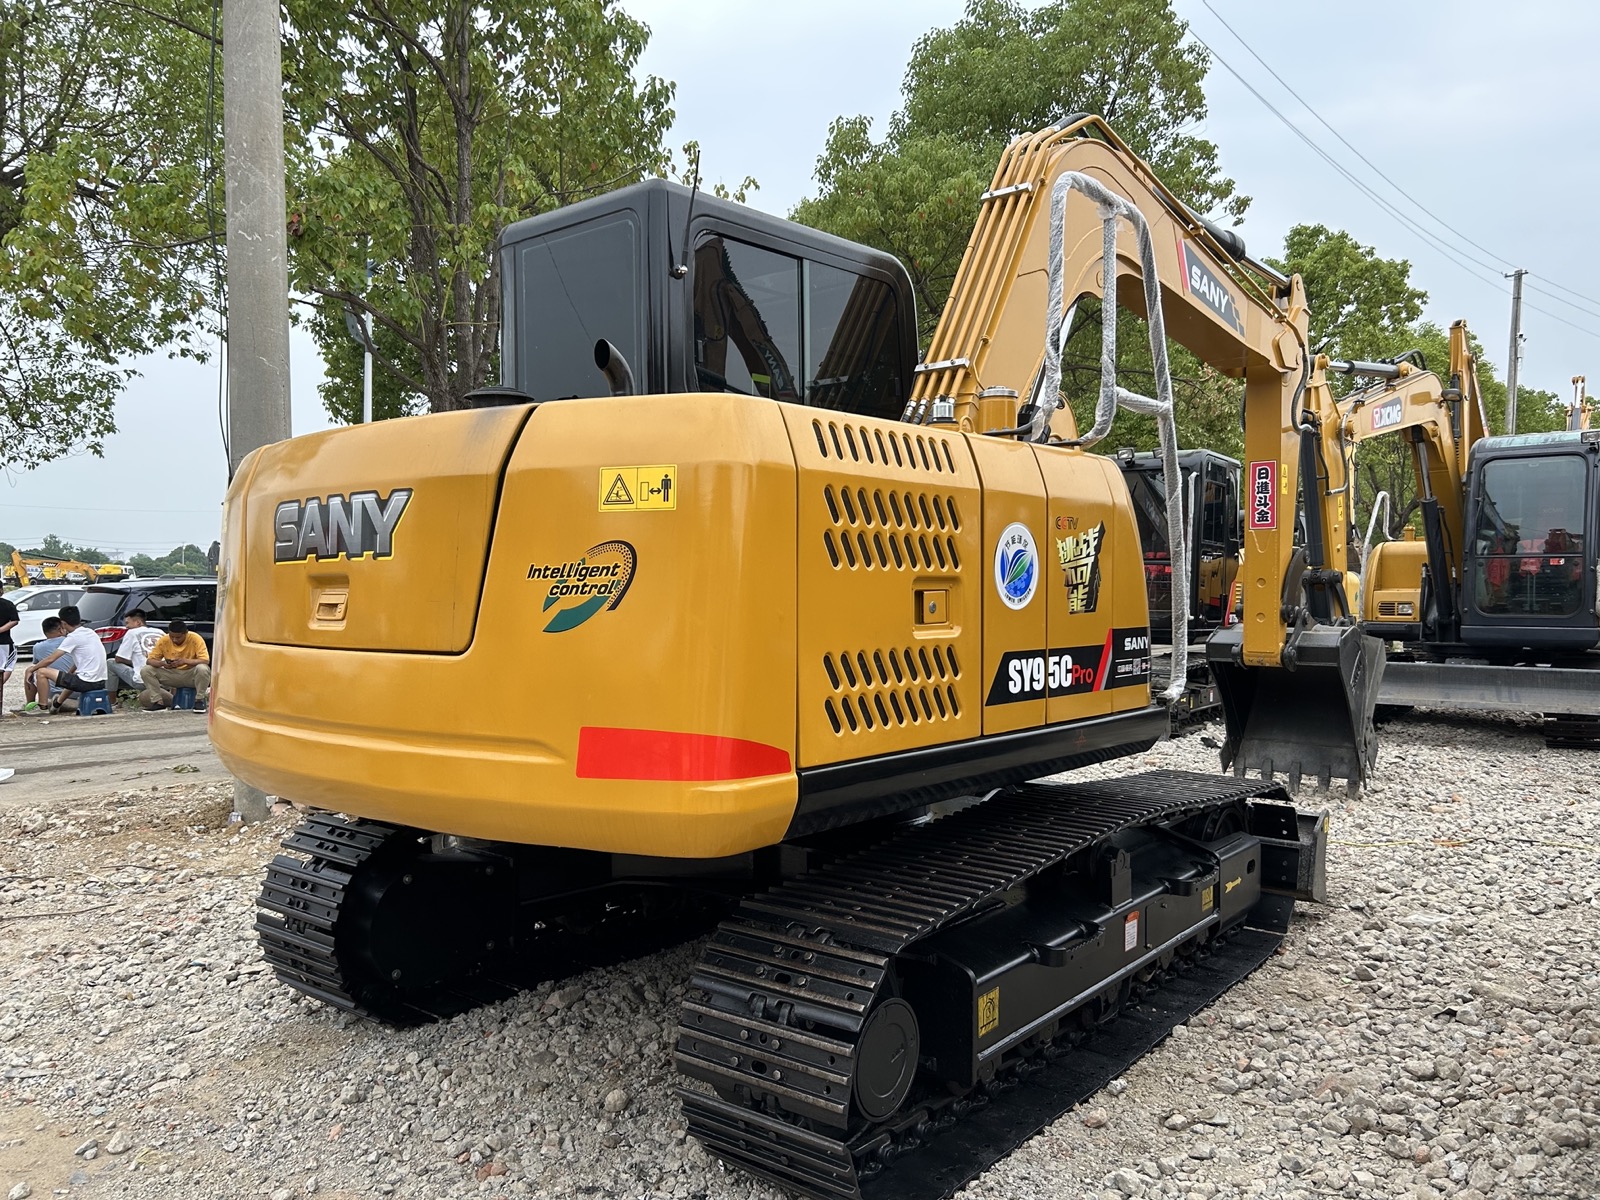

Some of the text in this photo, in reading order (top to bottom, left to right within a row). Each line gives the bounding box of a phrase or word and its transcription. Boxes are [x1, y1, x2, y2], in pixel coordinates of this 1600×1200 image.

[1191, 265, 1229, 313] SANY
[1380, 404, 1402, 426] XCMG
[1254, 466, 1271, 524] 日進斗金
[274, 488, 414, 564] SANY
[1055, 516, 1079, 530] CCTV
[527, 562, 621, 582] Intelligent
[549, 579, 616, 596] control
[1124, 636, 1149, 651] SANY
